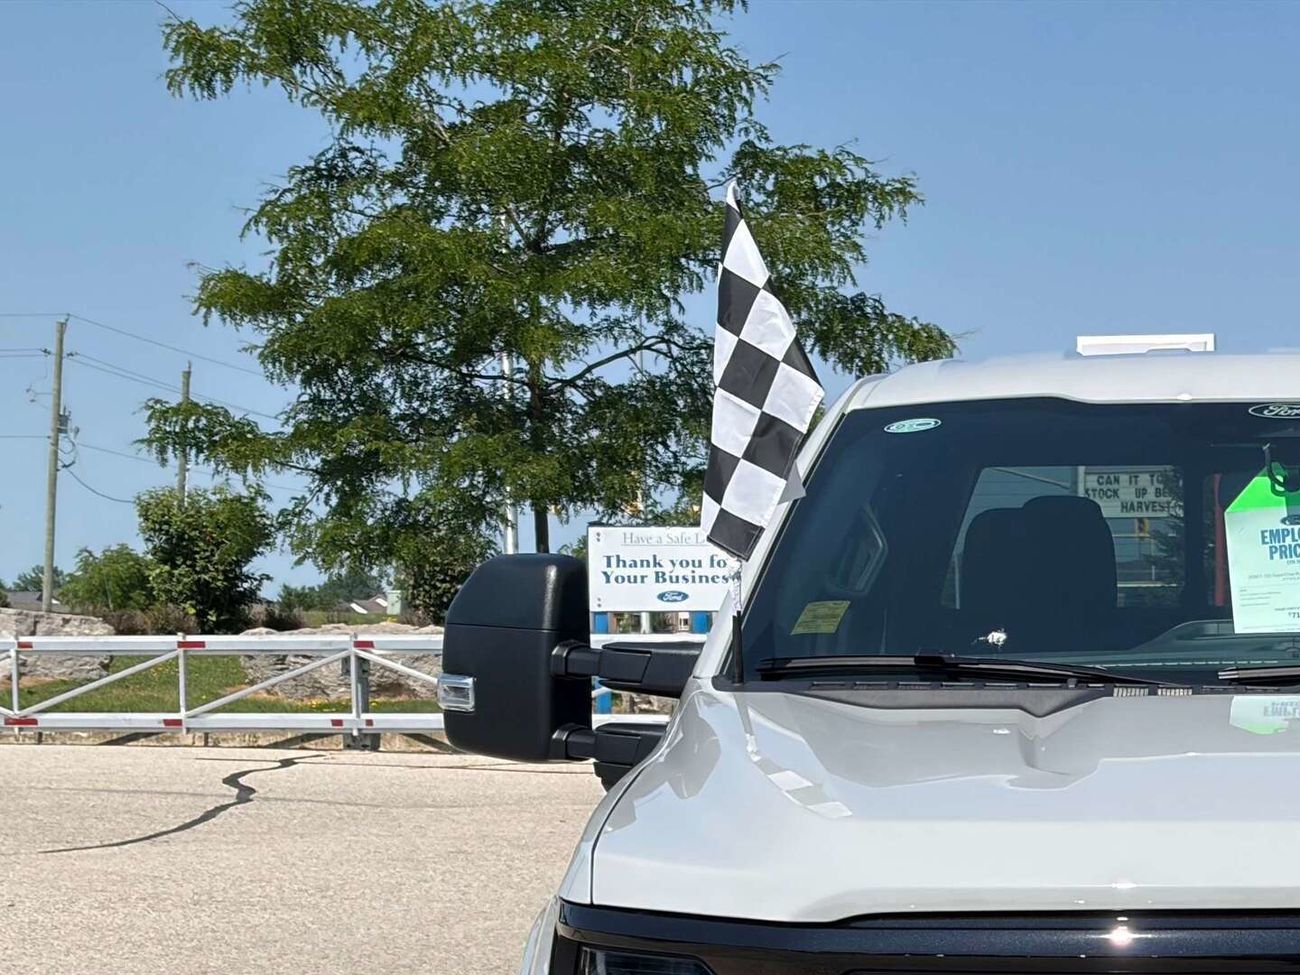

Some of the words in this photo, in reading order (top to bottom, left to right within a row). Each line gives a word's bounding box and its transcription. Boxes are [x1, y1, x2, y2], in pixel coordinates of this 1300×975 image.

[1097, 475, 1120, 486] CAN
[1129, 475, 1140, 486] IT
[1085, 488, 1120, 499] STOCK
[1135, 488, 1148, 499] UP
[623, 532, 653, 544] Have
[656, 535, 662, 544] a
[666, 532, 692, 544] Safe
[603, 554, 663, 569] Thank
[667, 558, 703, 573] you
[709, 554, 728, 569] fo
[601, 571, 648, 584] Your
[654, 570, 730, 584] Busines
